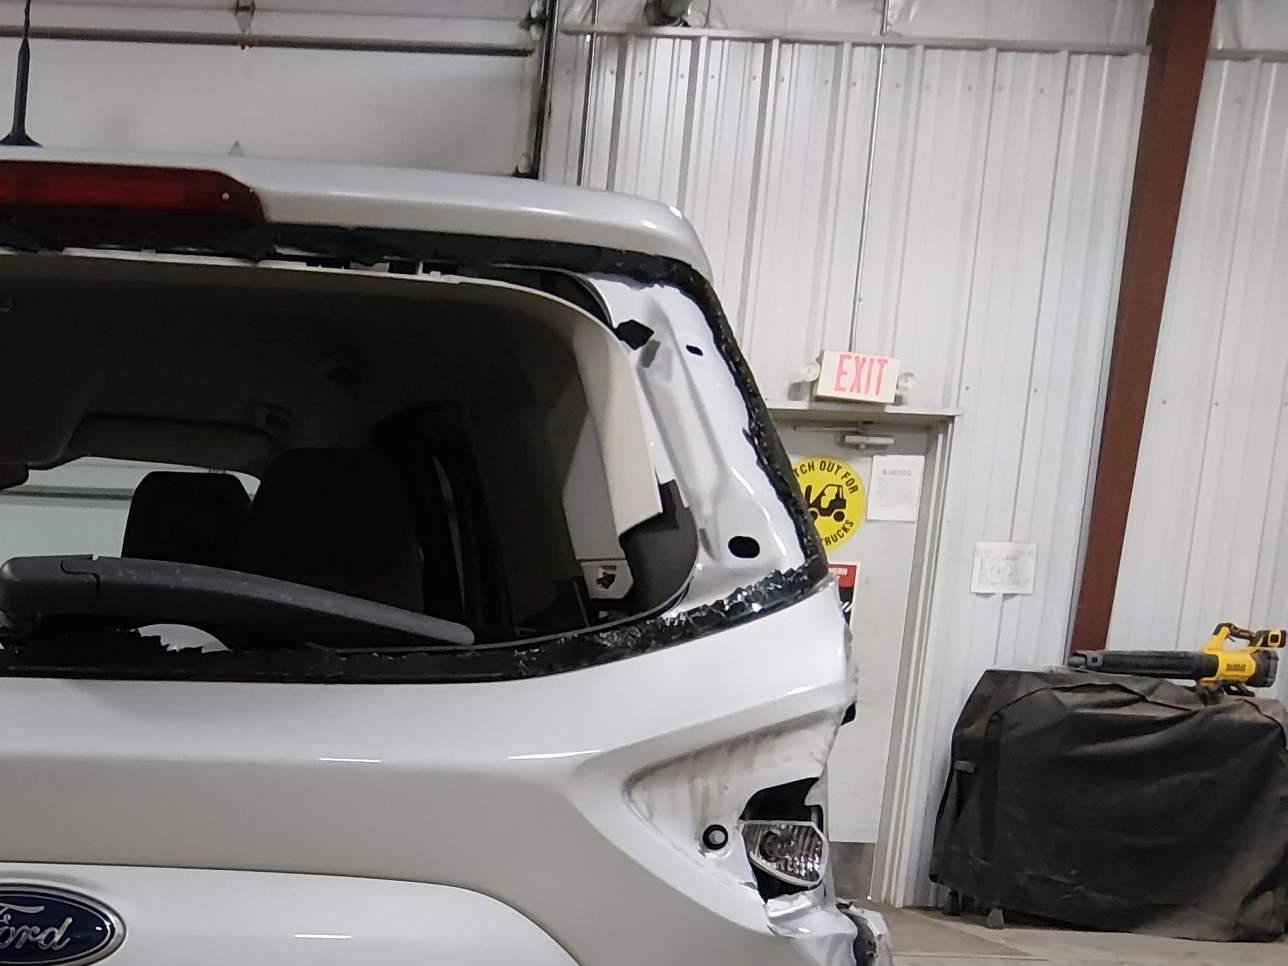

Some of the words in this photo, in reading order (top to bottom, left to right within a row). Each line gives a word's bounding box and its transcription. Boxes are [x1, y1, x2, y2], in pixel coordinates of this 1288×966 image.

[834, 354, 889, 396] EXIT
[793, 461, 816, 478] TCH
[819, 460, 843, 476] OUT
[841, 470, 859, 495] FOR
[821, 519, 855, 547] RUCKS
